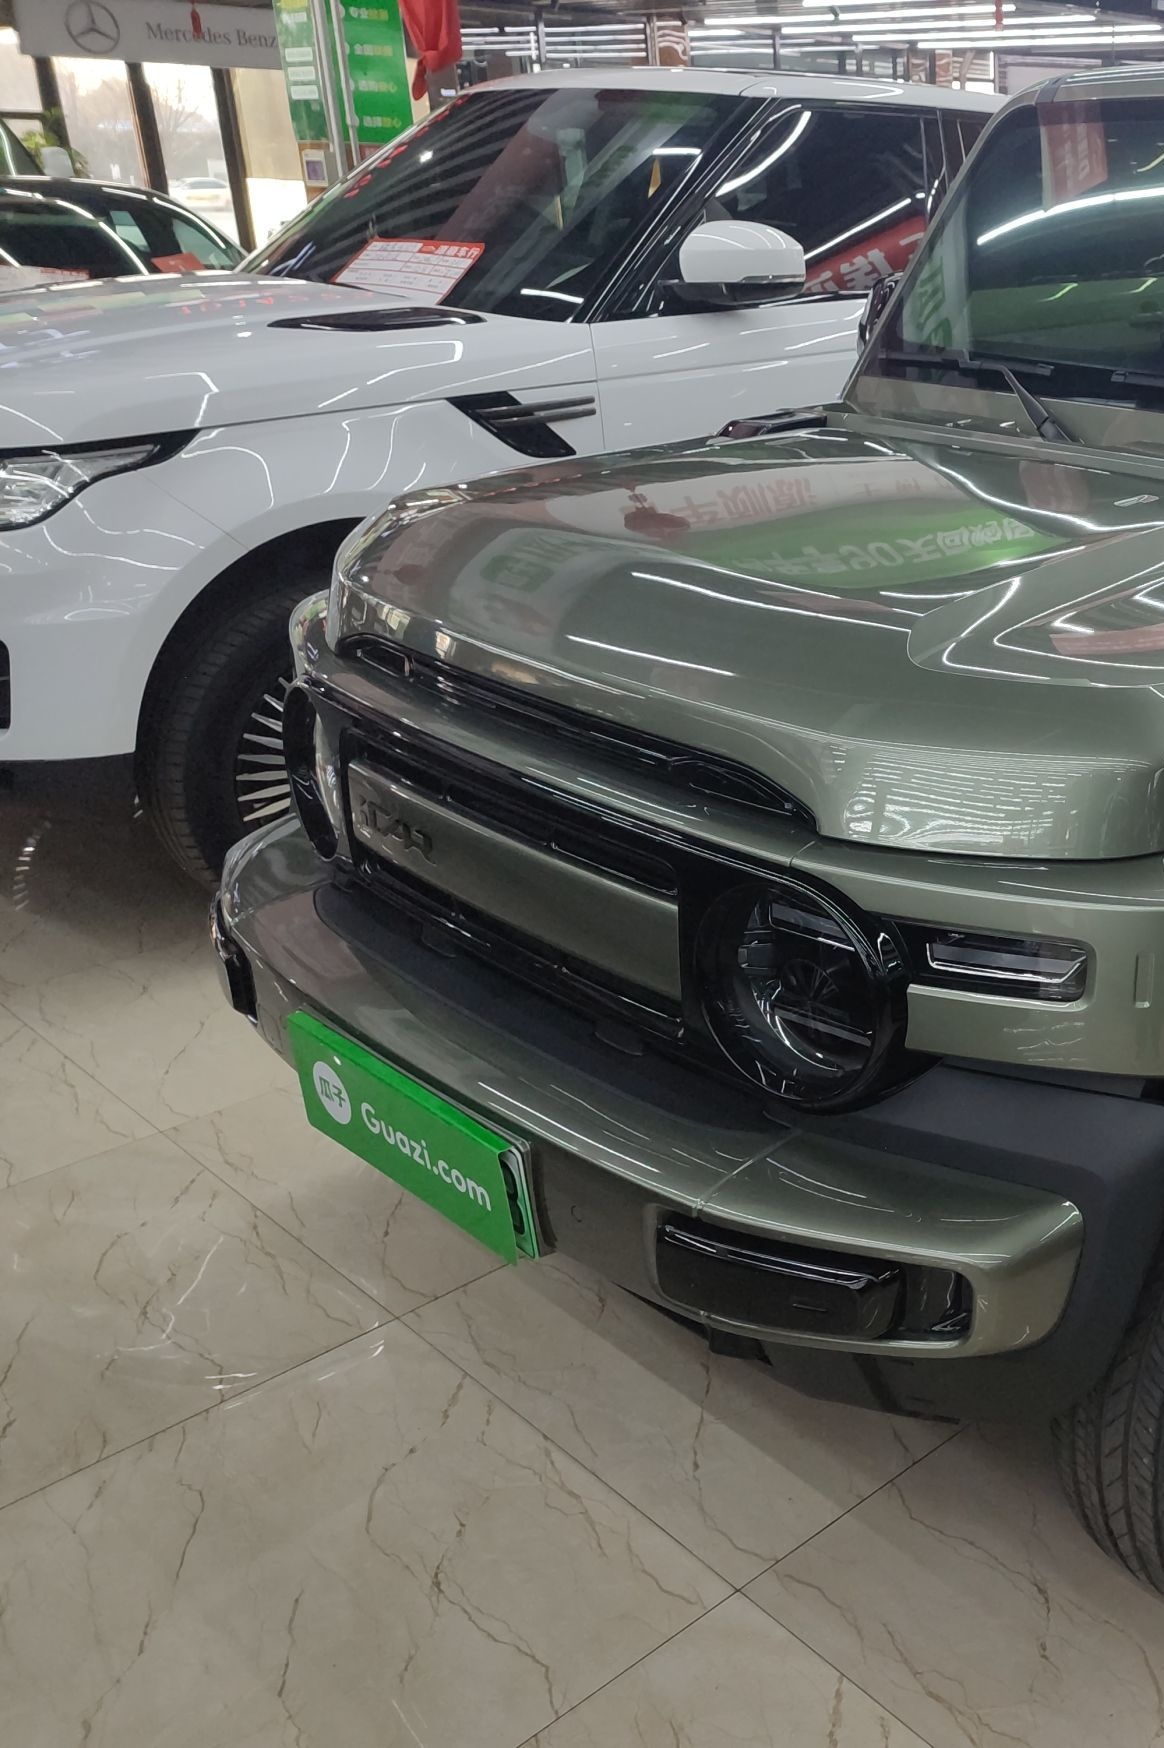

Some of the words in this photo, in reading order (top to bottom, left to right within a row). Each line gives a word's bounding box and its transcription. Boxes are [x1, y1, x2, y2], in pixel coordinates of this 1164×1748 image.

[145, 21, 232, 46] Mercdes
[318, 1075, 346, 1108] 瓜子
[361, 1102, 492, 1212] Guazi.com
